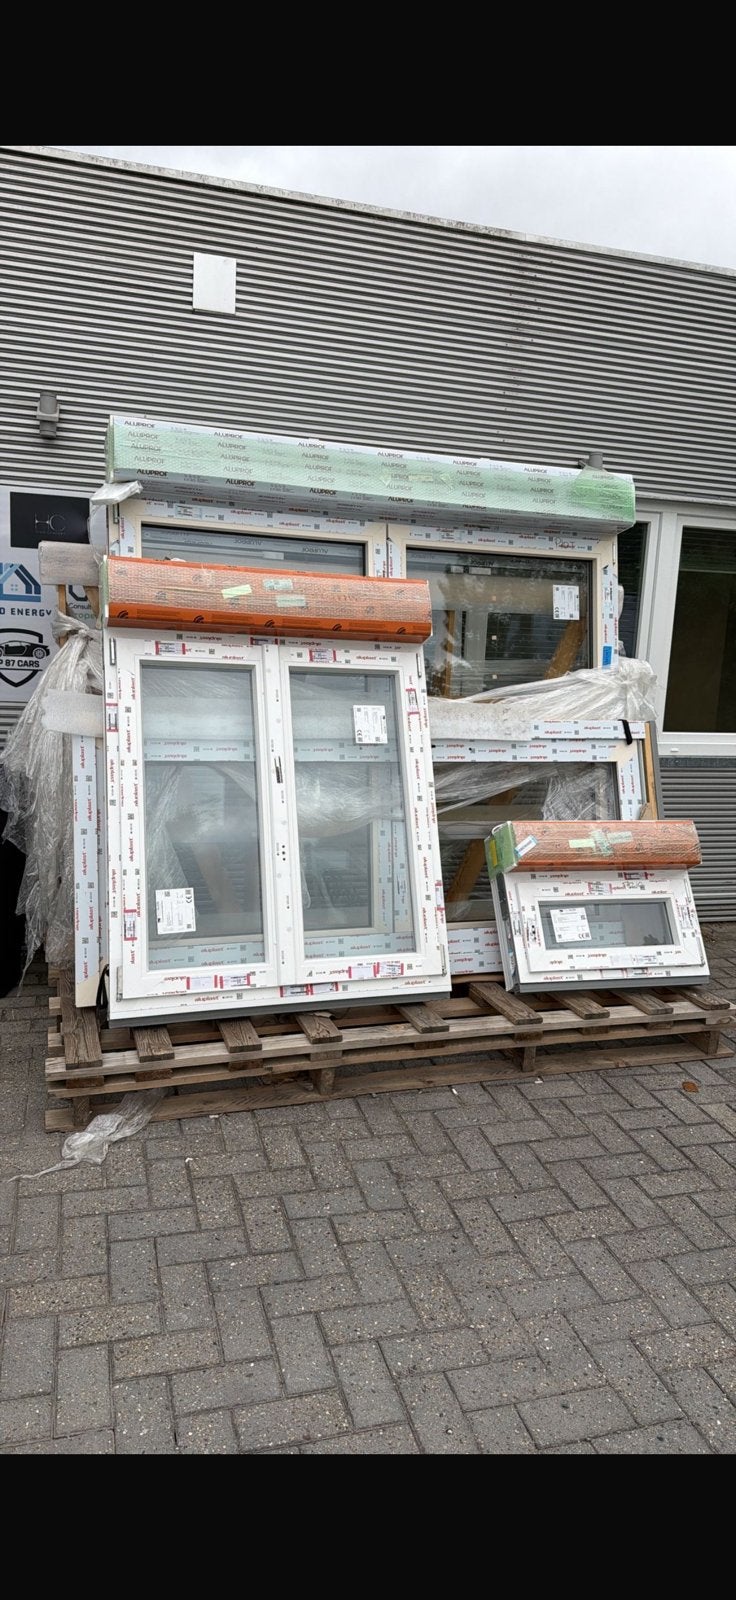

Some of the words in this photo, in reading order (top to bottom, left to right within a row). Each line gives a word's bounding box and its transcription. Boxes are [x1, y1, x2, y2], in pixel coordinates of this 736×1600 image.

[124, 420, 155, 428] ALUPROF
[128, 431, 159, 439] ALUPROF
[213, 431, 243, 439] ALUPROF
[218, 442, 247, 450] ALUPROF
[298, 441, 325, 449] ALUPROF
[221, 453, 250, 462] ALUPROF
[302, 452, 329, 460] ALUPROF
[377, 451, 404, 459] ALUPROF
[305, 463, 332, 471] ALUPROF
[381, 461, 407, 469] ALUPROF
[137, 468, 168, 477] ALUPROF
[226, 478, 256, 487] ALUPROF
[309, 487, 338, 495] ALUPROF
[5, 659, 15, 667] 87
[17, 660, 40, 668] CARS
